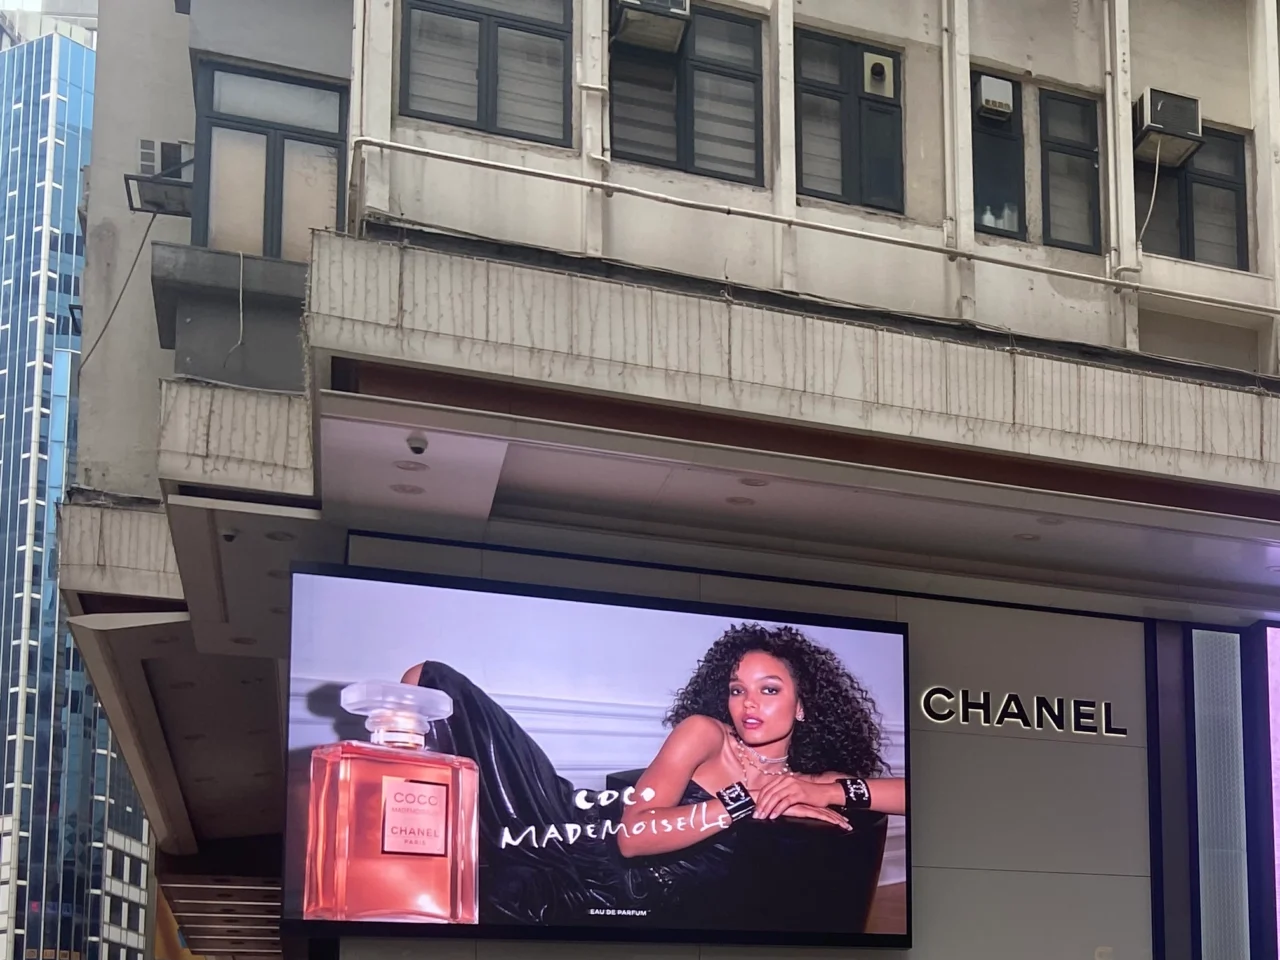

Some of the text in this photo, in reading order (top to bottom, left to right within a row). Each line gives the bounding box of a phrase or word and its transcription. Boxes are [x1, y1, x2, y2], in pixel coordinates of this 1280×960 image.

[922, 687, 1128, 740] CHANEL
[390, 826, 440, 838] CHANEL
[617, 909, 648, 917] PARFUM
